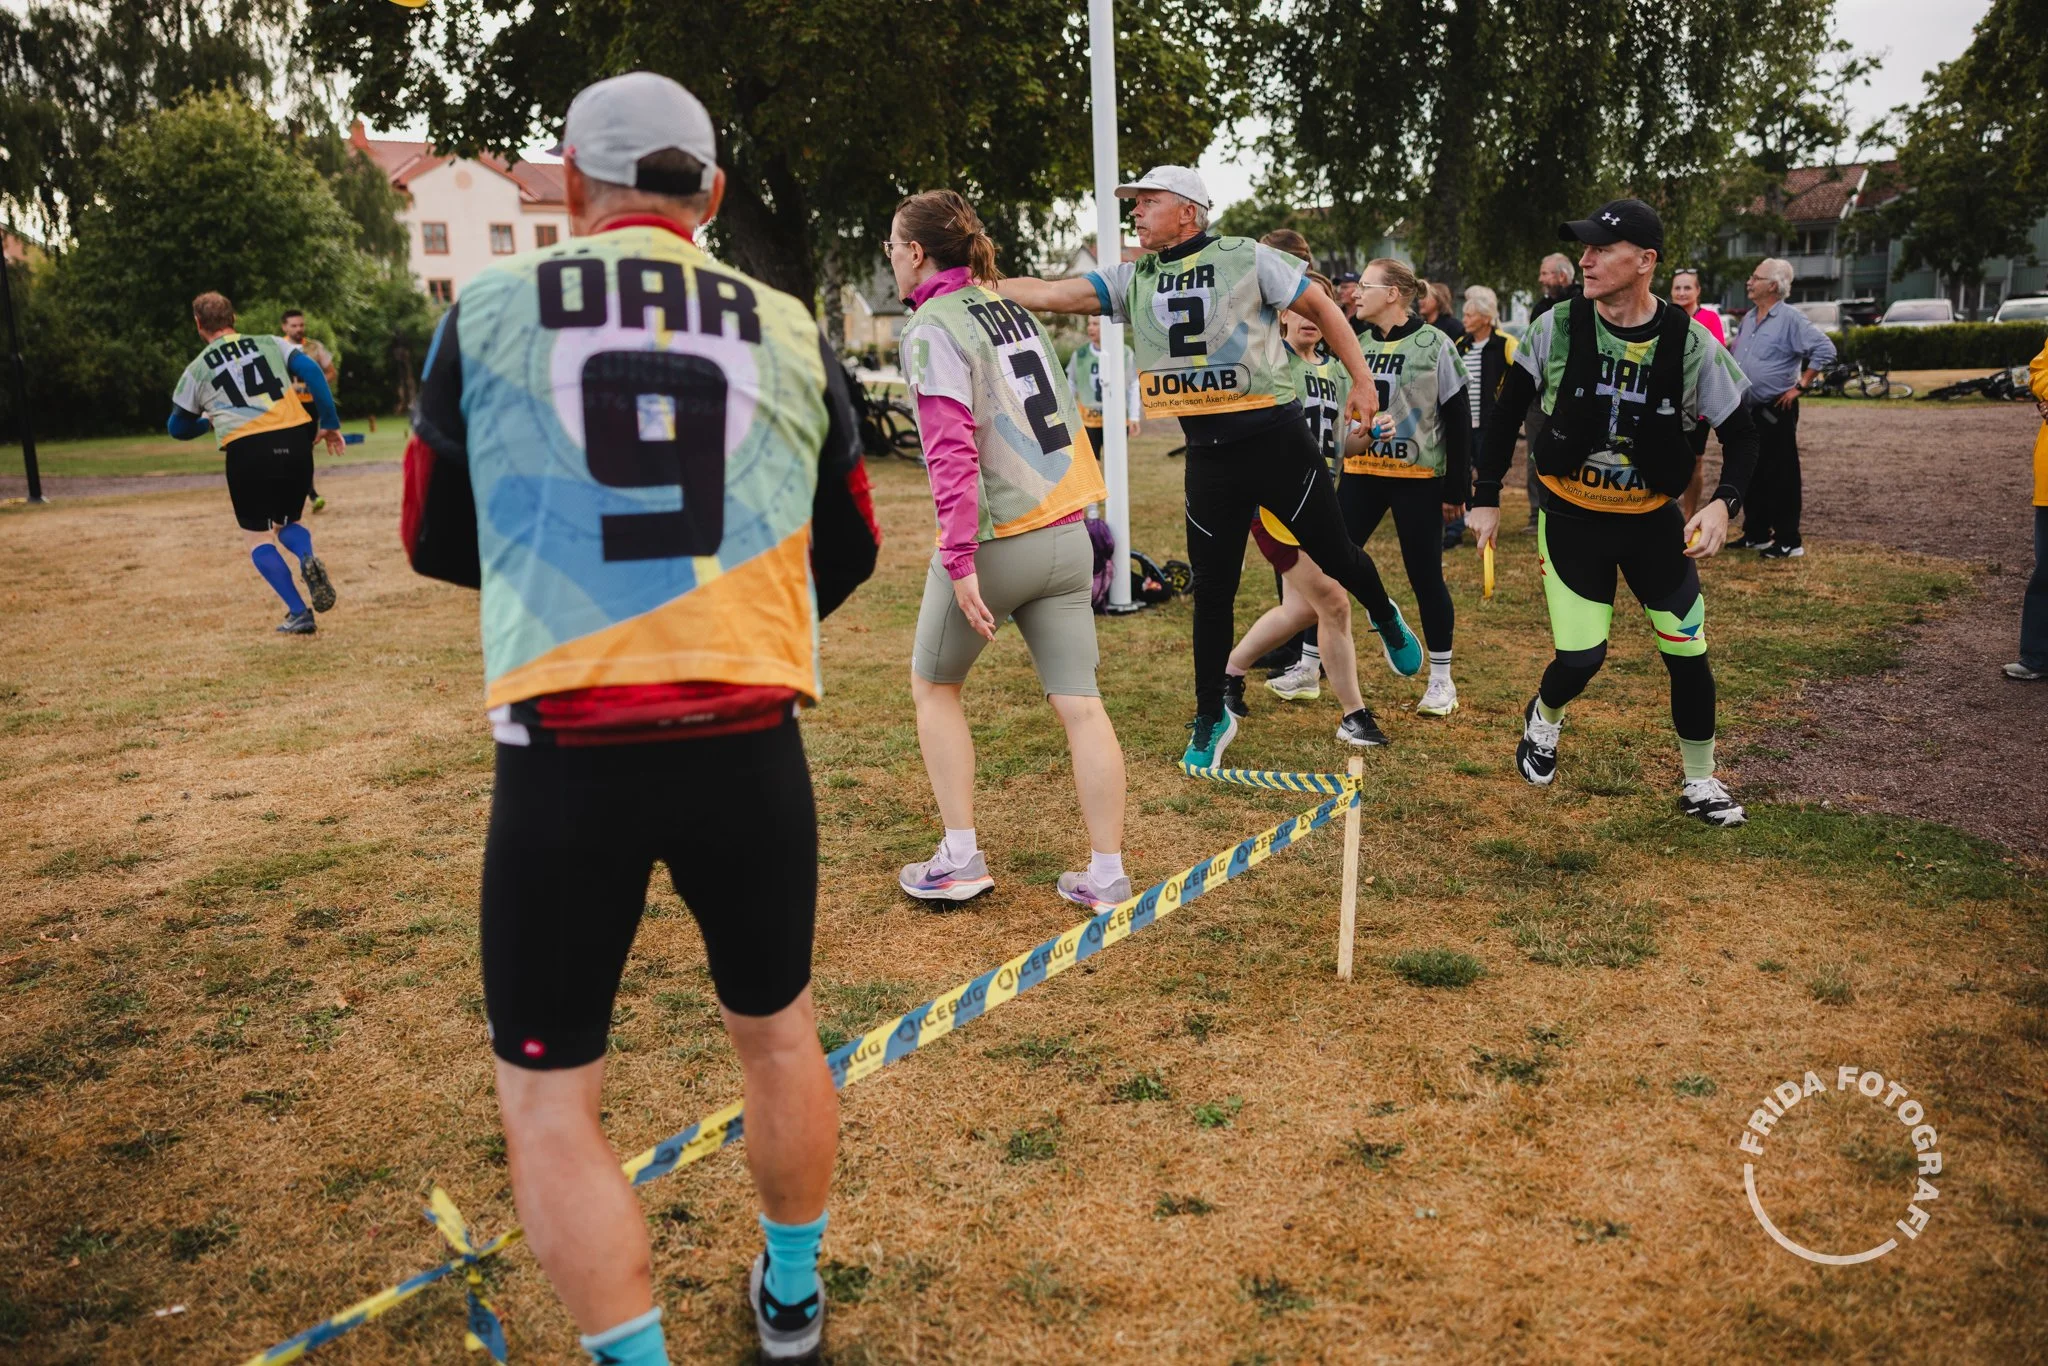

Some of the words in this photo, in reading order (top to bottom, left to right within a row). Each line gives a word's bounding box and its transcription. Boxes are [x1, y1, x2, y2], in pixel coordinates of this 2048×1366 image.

[1157, 262, 1215, 294] ÖAR
[962, 298, 1040, 347] ÖAR
[1167, 296, 1207, 358] 2
[211, 354, 284, 408] 14
[1008, 349, 1072, 456] 2
[1146, 369, 1238, 397] JOKAB
[1148, 400, 1168, 409] John
[1169, 397, 1204, 406] Karlsson
[581, 350, 729, 562] 9
[1179, 858, 1226, 893] ICEBUG
[1103, 896, 1156, 934] ICEBUG
[1015, 938, 1074, 979] ICEBUG
[918, 986, 984, 1031] ICEBUG
